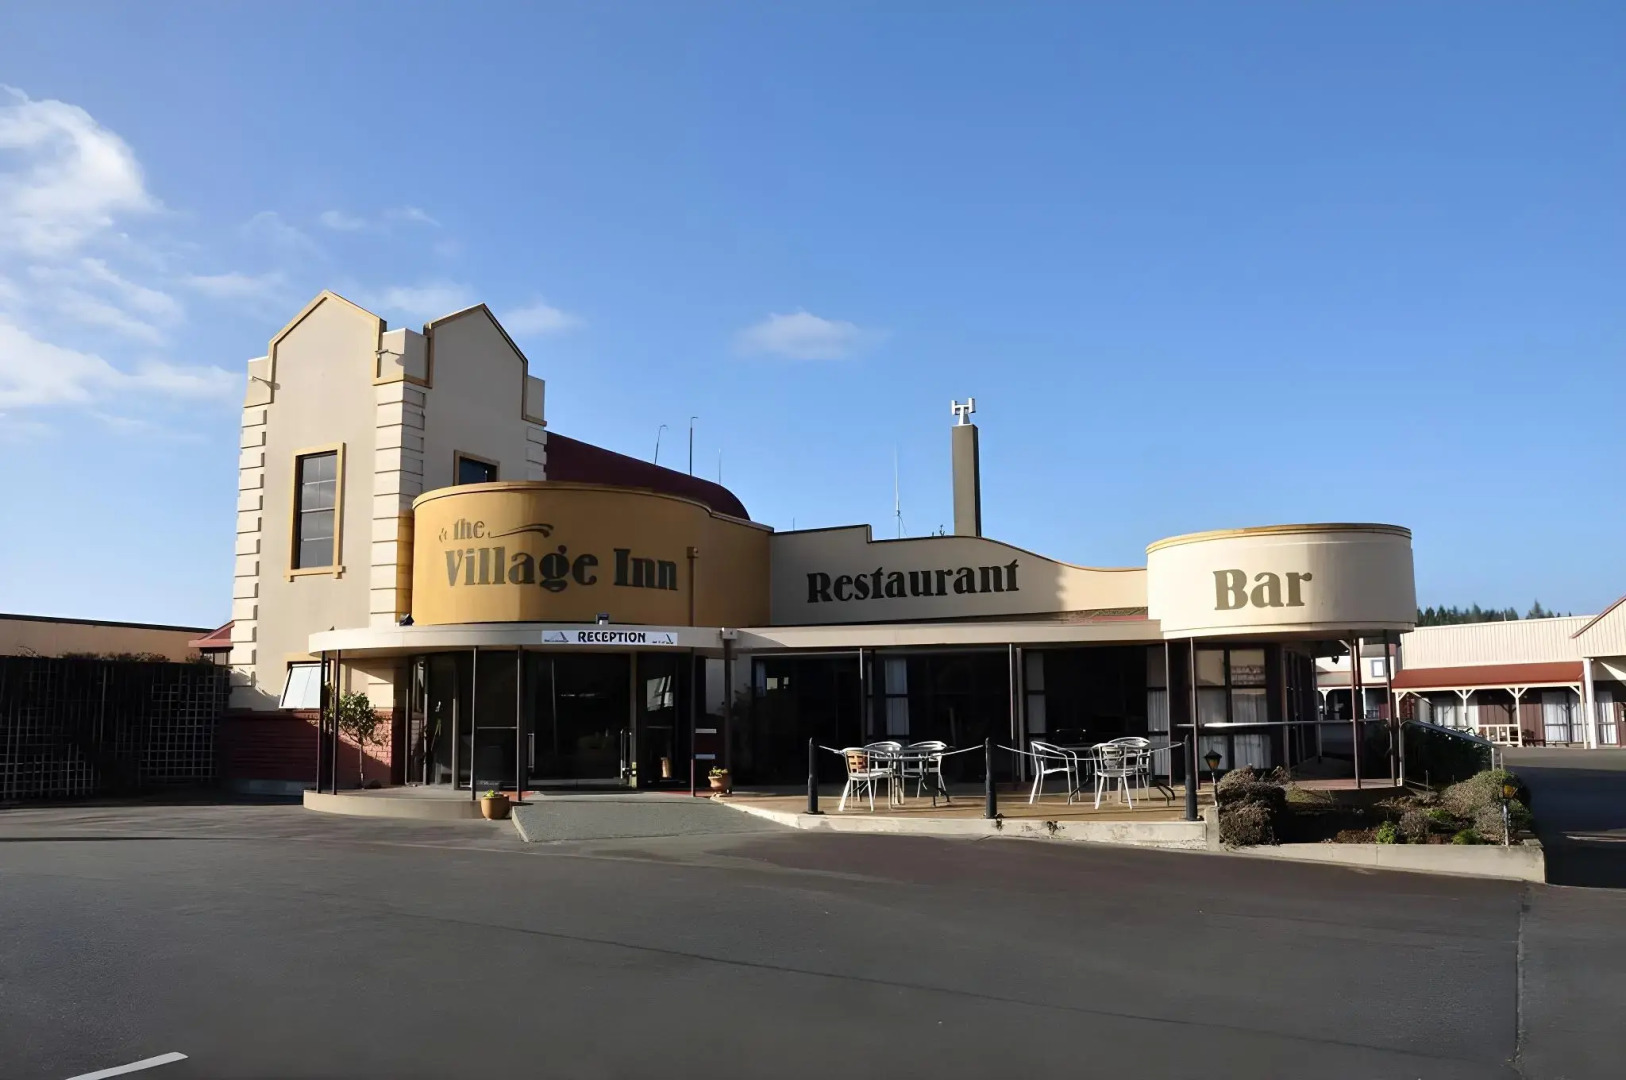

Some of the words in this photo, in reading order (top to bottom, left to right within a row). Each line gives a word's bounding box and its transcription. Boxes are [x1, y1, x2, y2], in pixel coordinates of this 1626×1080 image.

[453, 518, 485, 540] the
[445, 545, 599, 593] Village
[613, 547, 678, 591] Inn
[806, 559, 1019, 604] Restaurant
[1212, 568, 1313, 610] Bar
[577, 631, 646, 643] RECEPTION
